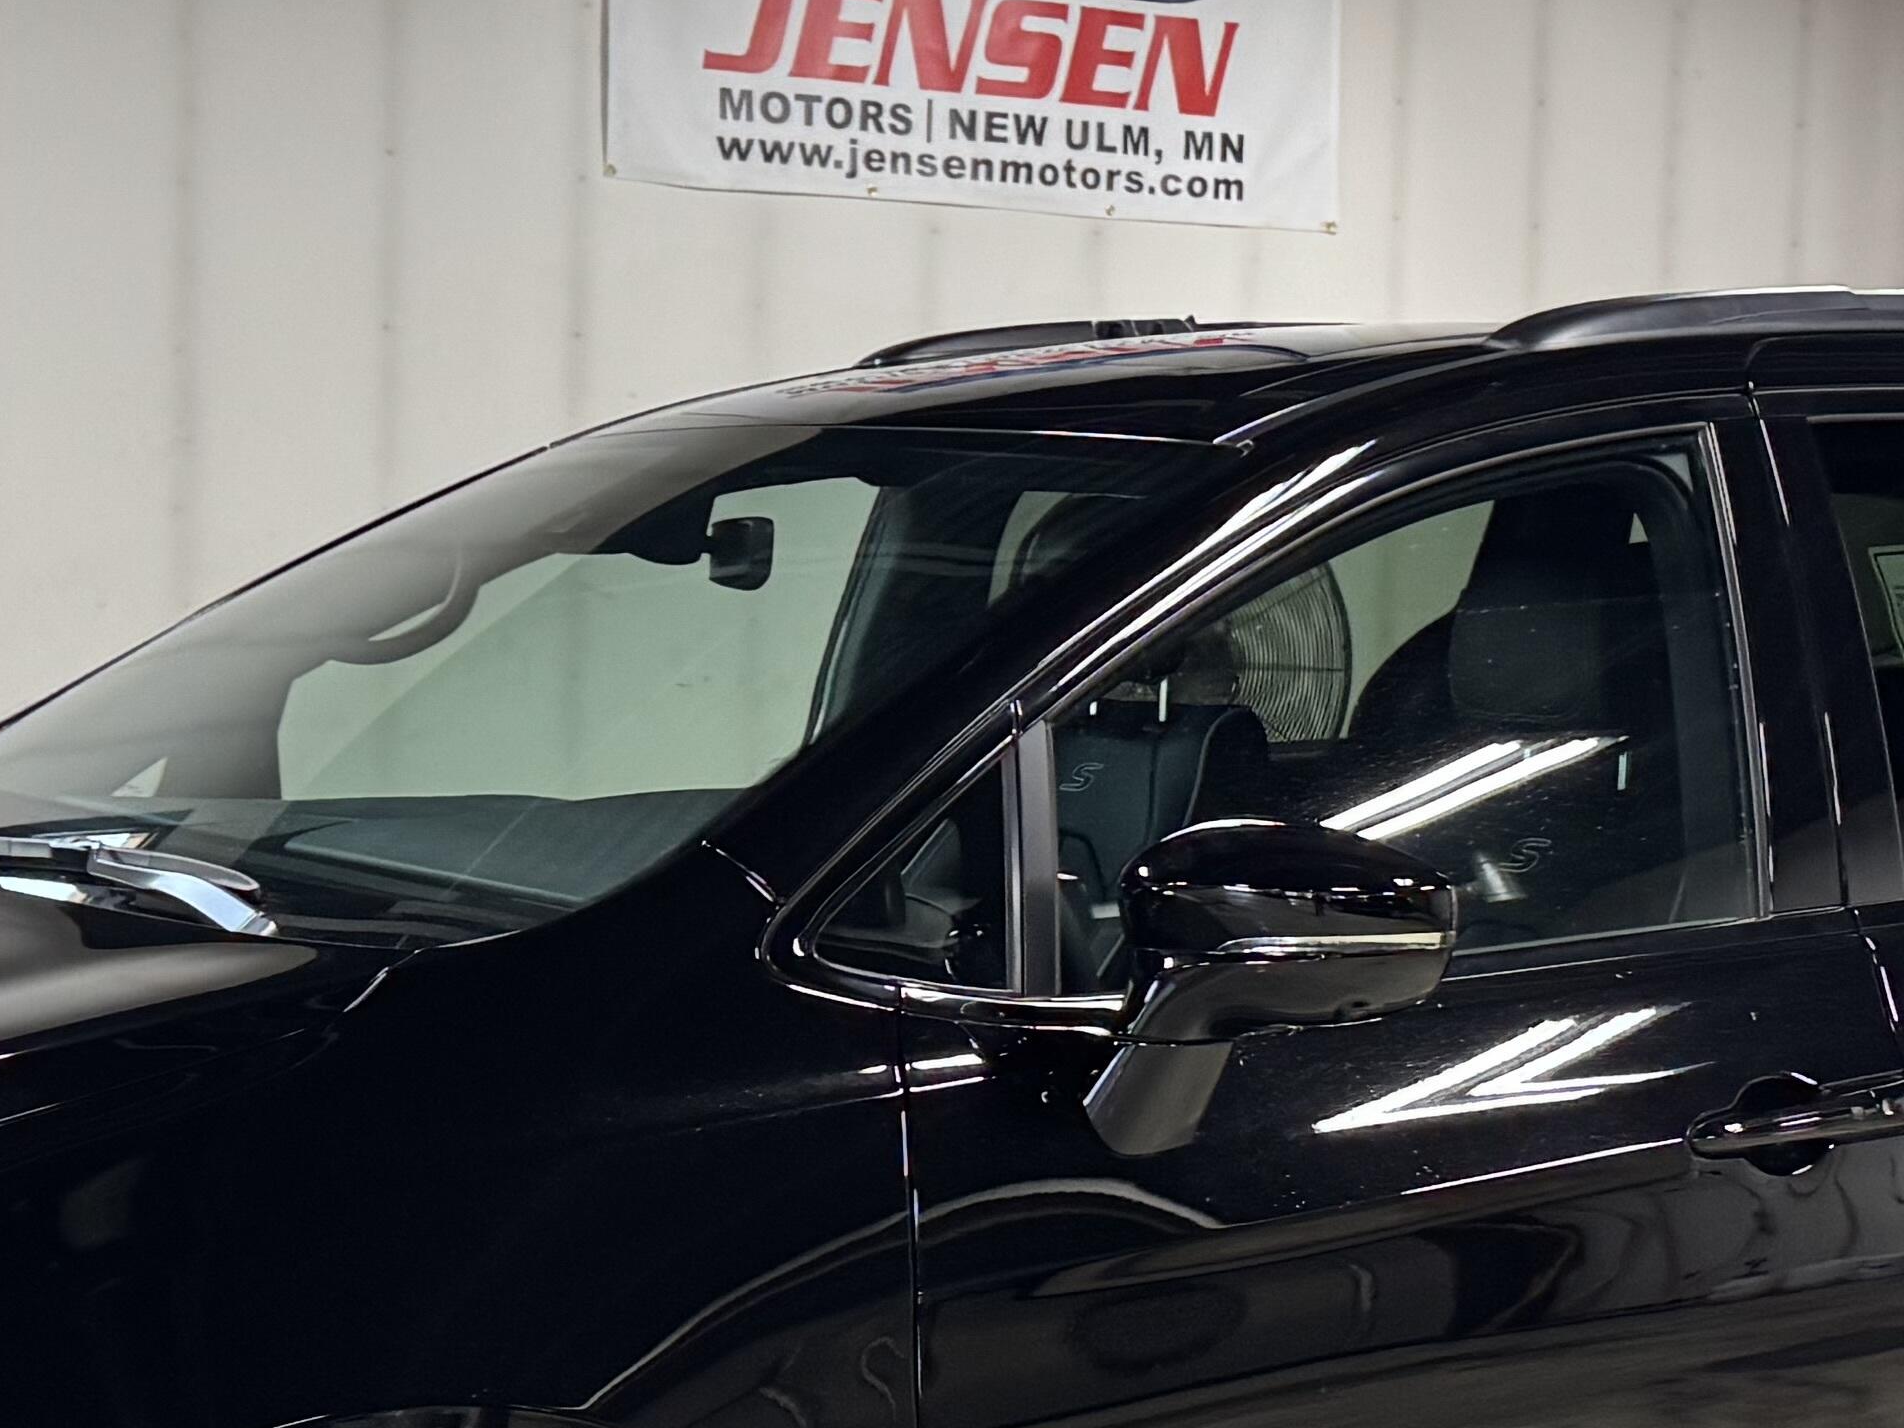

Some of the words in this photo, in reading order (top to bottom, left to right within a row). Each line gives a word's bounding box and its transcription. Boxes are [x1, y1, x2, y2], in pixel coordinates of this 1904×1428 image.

[718, 86, 914, 137] MOTORS
[948, 107, 1048, 147] NEW
[1065, 118, 1163, 166] ULM,
[1183, 129, 1246, 165] MN
[716, 135, 1245, 203] www.jensenmotors.com
